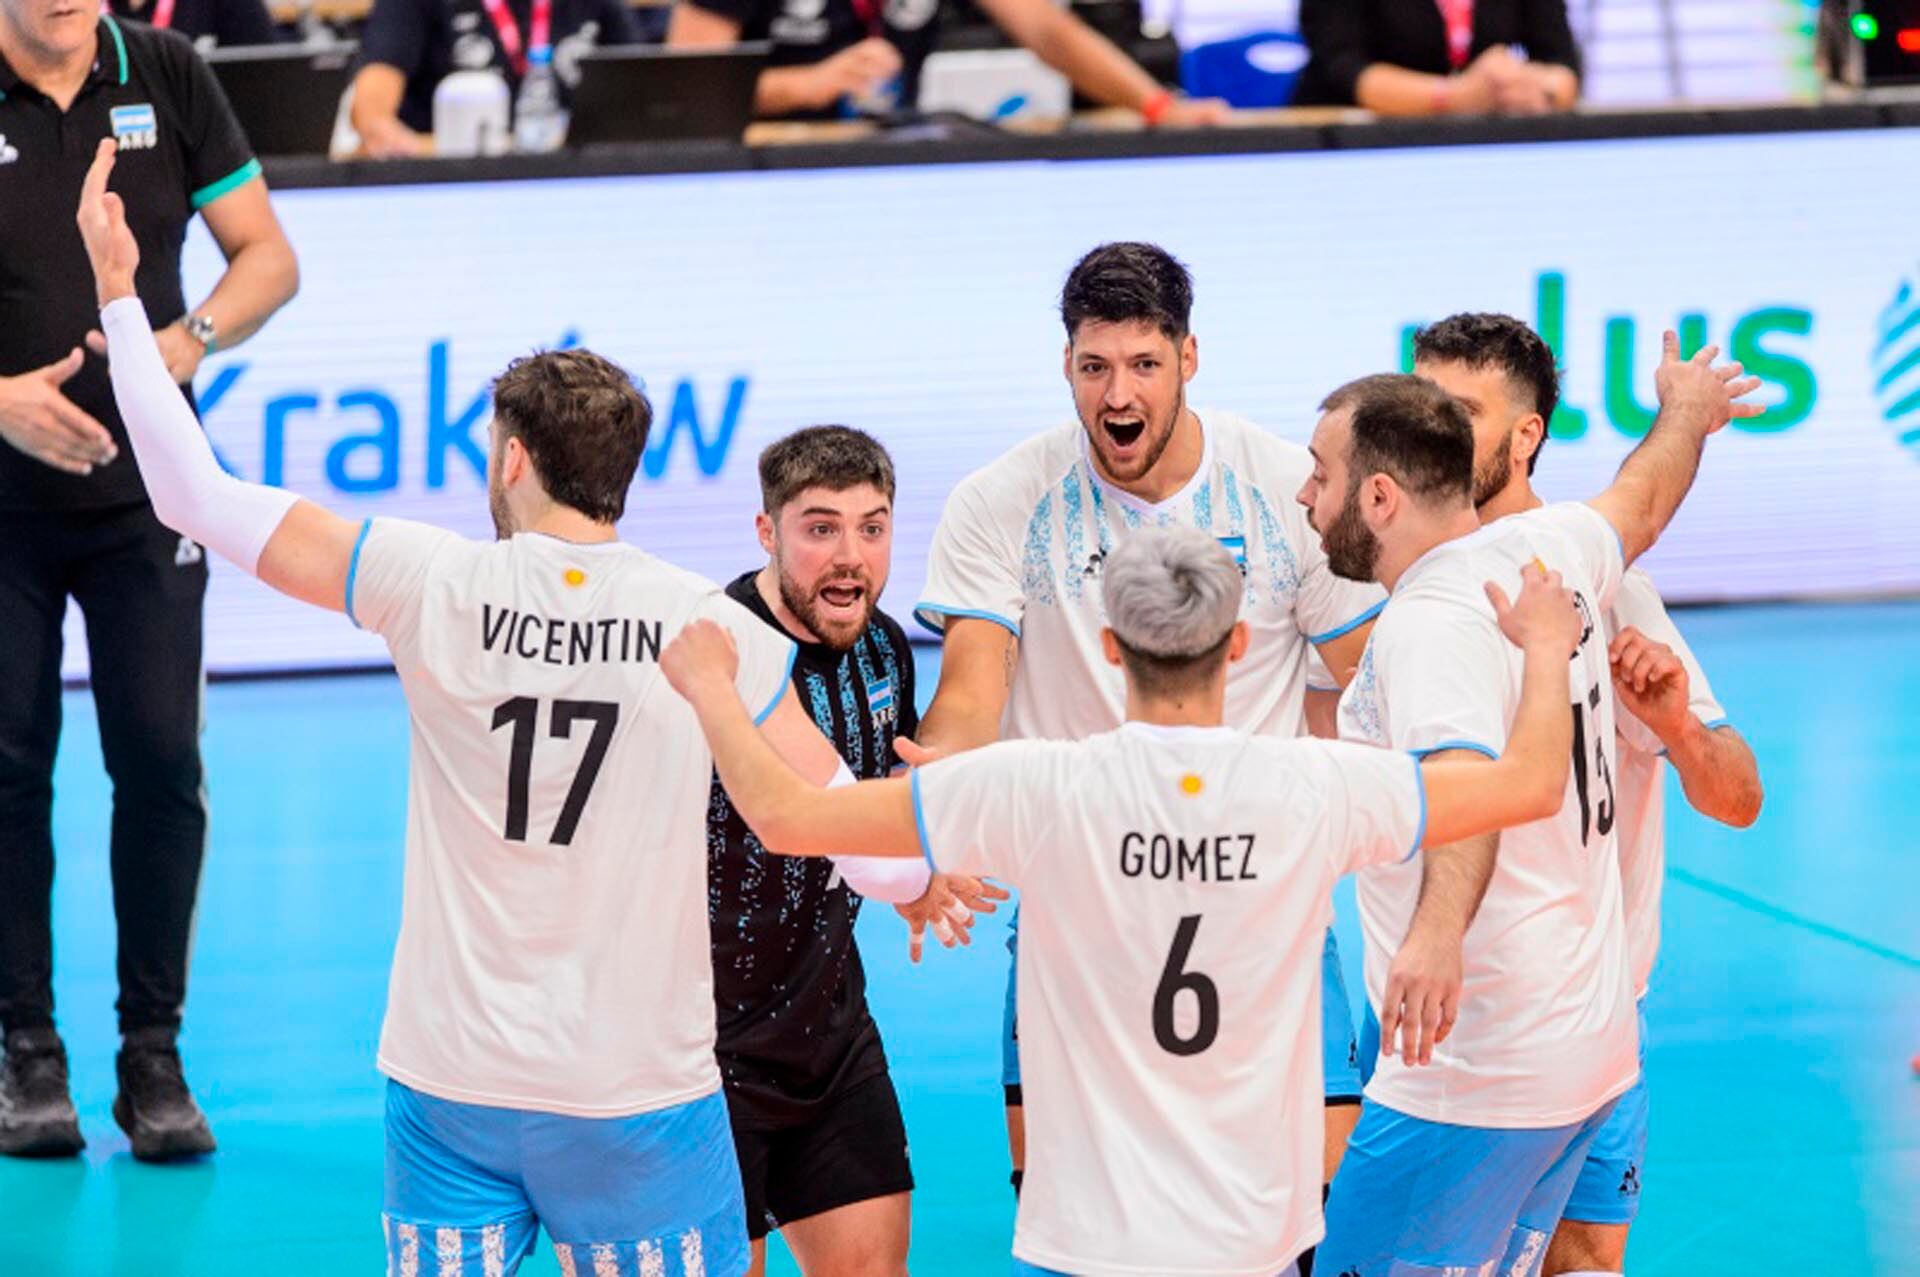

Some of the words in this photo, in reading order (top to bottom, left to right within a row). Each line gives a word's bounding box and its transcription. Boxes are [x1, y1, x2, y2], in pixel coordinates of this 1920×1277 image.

[199, 327, 750, 495] rakw
[1401, 271, 1817, 440] lus
[482, 603, 663, 666] VICENTIN
[489, 695, 620, 846] 17
[1120, 832, 1257, 882] GOMEZ
[1152, 913, 1220, 1057] 6
